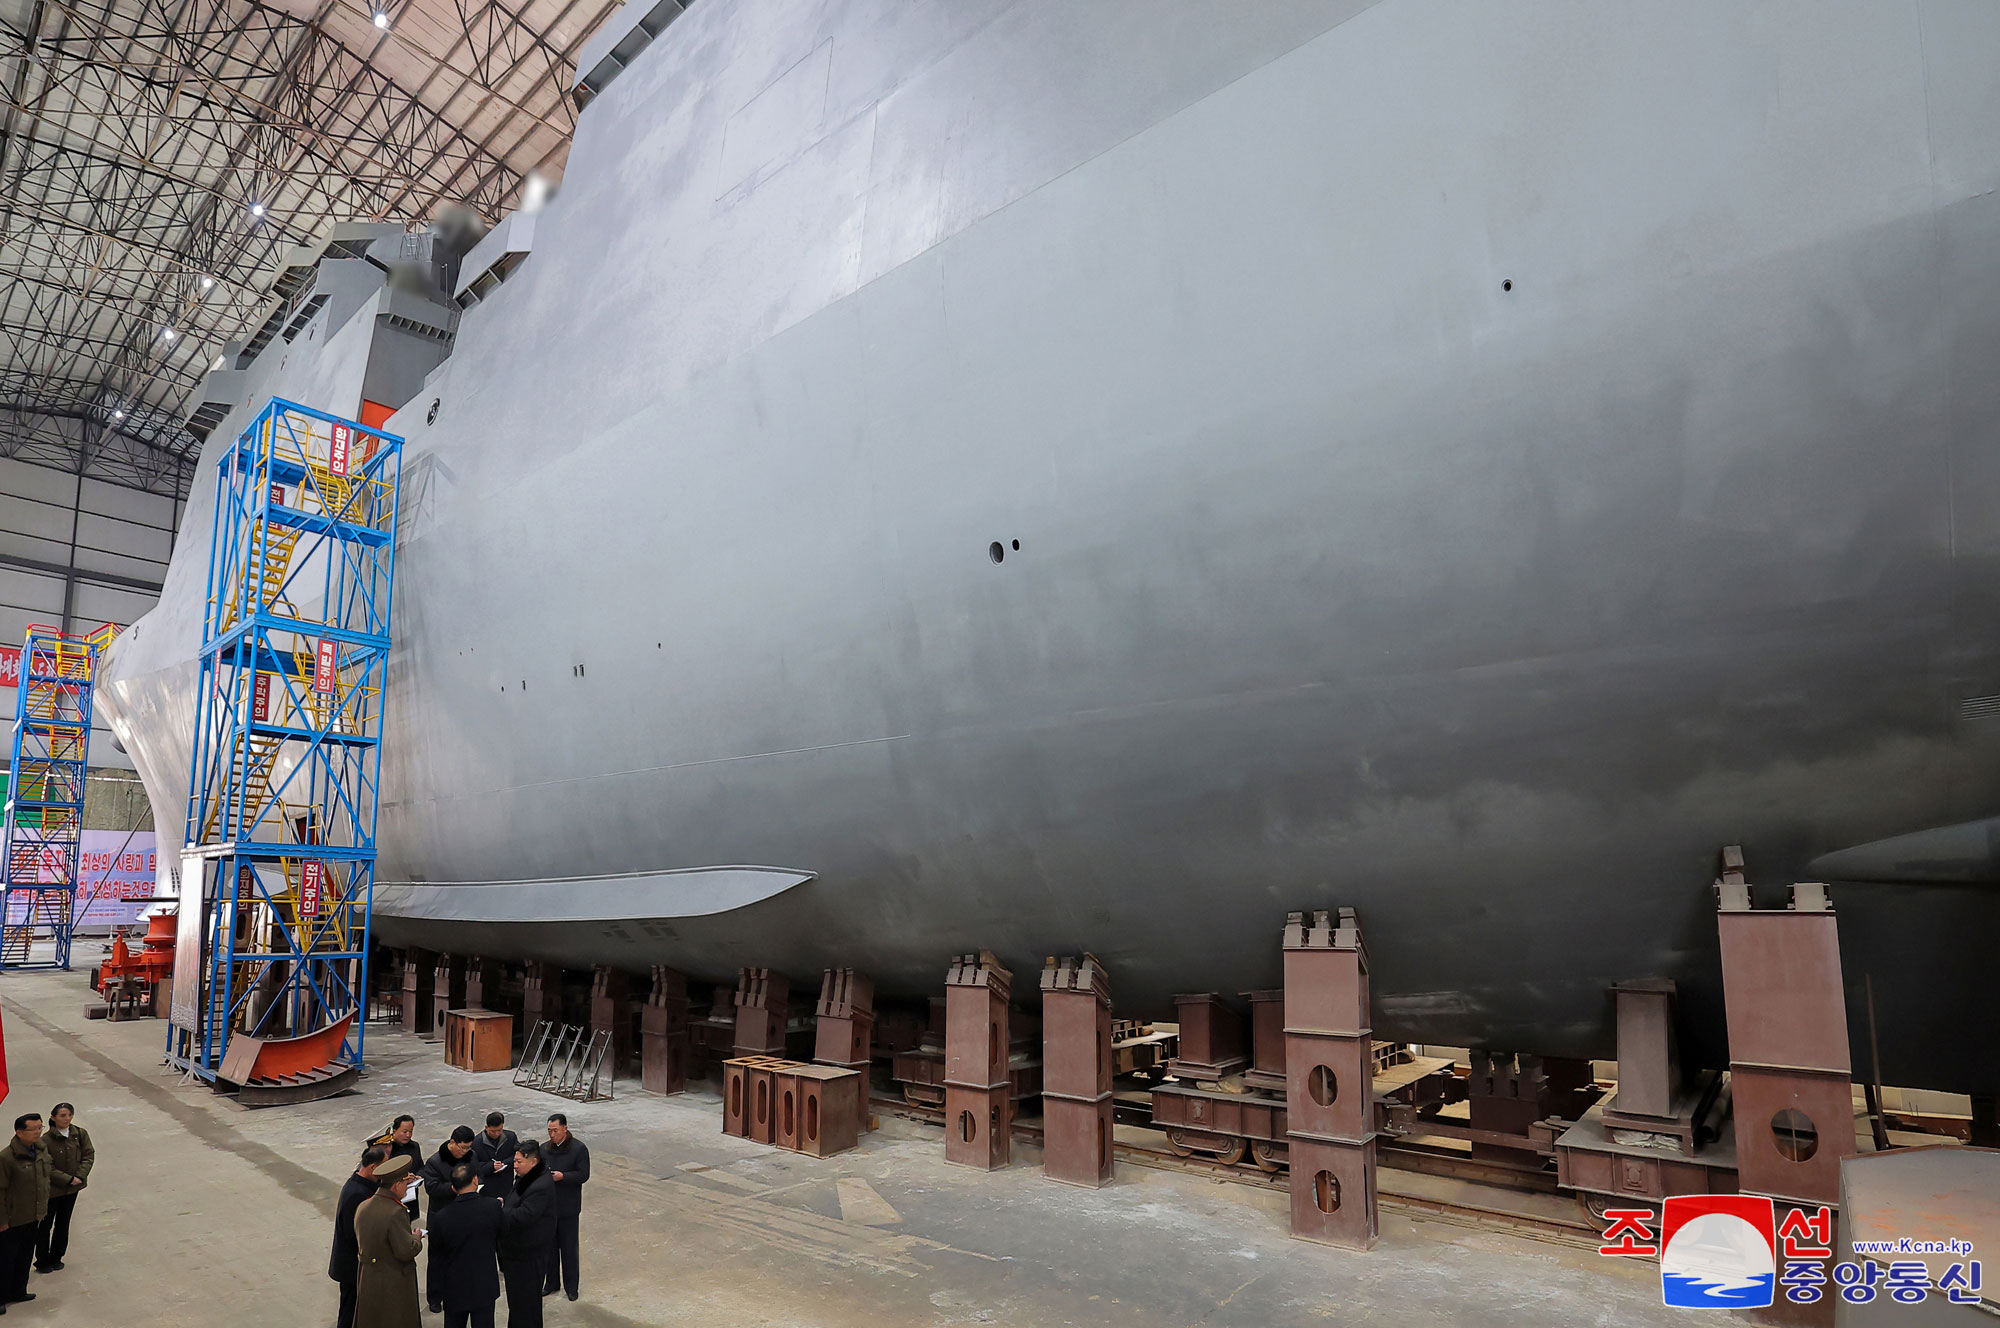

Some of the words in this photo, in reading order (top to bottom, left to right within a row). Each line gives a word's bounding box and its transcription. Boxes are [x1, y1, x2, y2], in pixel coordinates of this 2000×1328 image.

[319, 642, 333, 690] 폭발주의
[81, 852, 110, 872] 최상의
[116, 853, 144, 872] 사랑과
[303, 864, 318, 913] 전기주의
